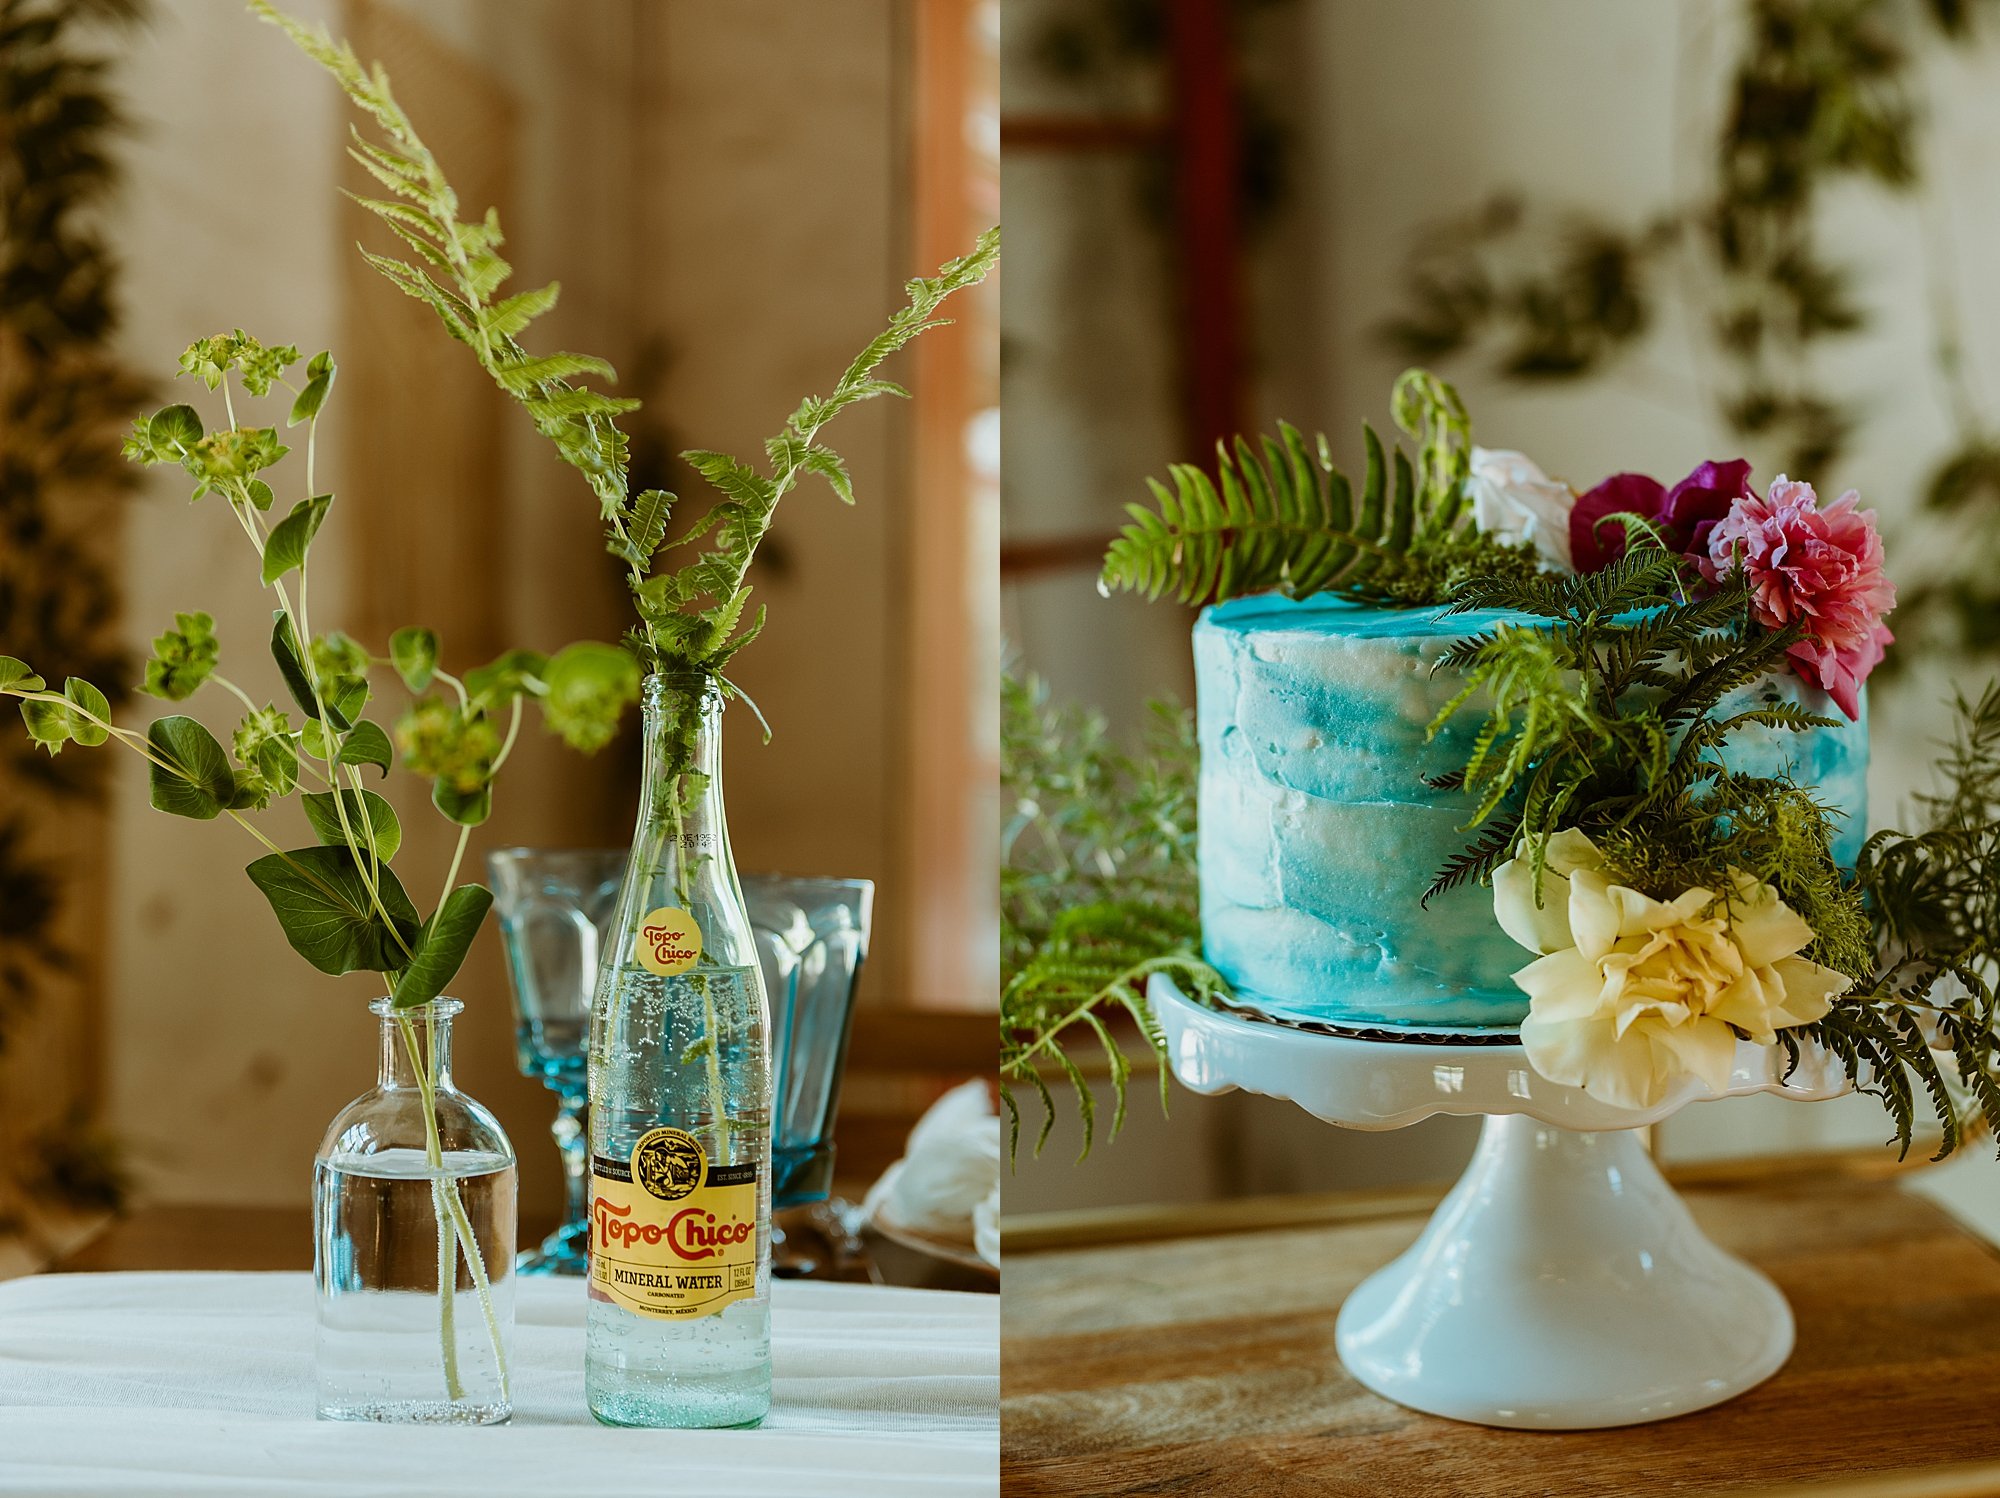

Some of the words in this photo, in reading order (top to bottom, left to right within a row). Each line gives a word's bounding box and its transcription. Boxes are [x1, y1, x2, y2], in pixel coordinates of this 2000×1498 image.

[643, 925, 686, 946] Topo
[655, 943, 698, 965] Chico
[661, 1129, 688, 1141] MINERAL
[594, 1196, 664, 1249] Topo
[666, 1207, 755, 1261] Chico
[614, 1268, 673, 1289] MINERAL
[675, 1275, 723, 1290] WATER
[733, 1268, 740, 1278] 12
[647, 1291, 685, 1299] CARBONATED
[639, 1304, 675, 1316] MONTERREY,
[675, 1306, 698, 1315] MÉXICO
